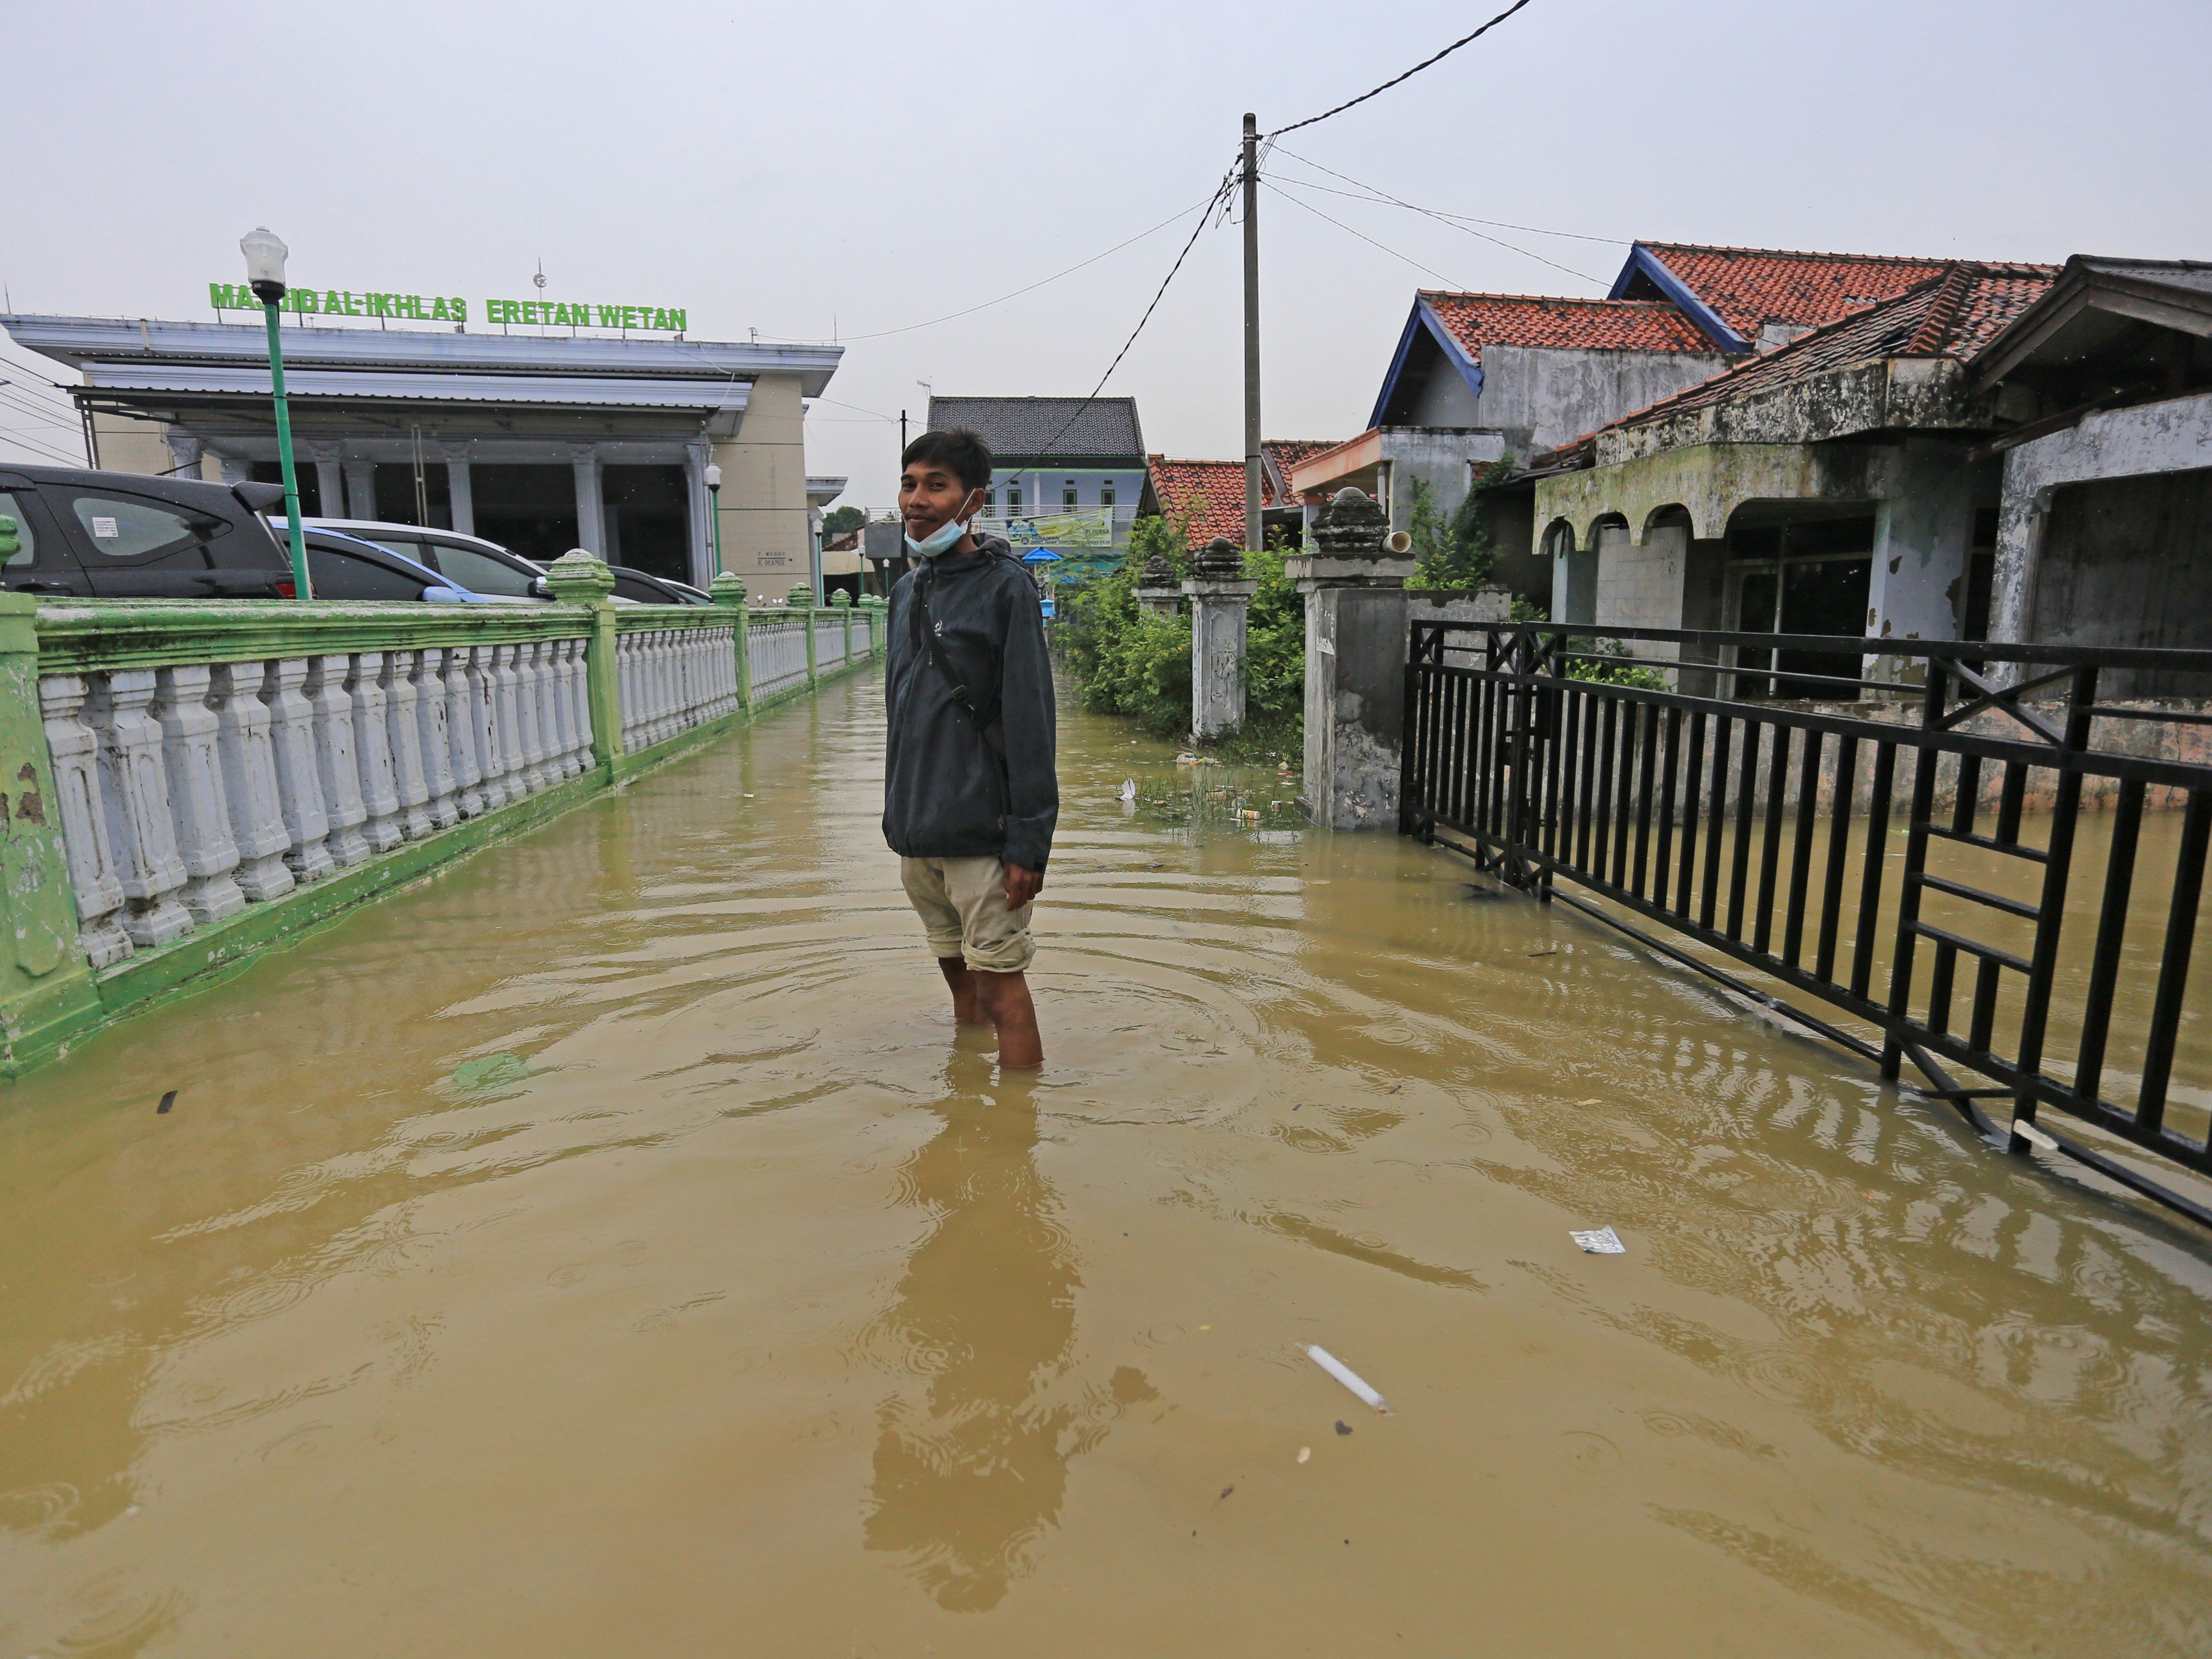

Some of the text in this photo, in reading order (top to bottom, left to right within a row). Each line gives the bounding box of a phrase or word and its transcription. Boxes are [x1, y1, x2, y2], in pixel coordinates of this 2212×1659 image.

[210, 283, 687, 331] MAJID AL-IKHLAS ERETAN WETAN
